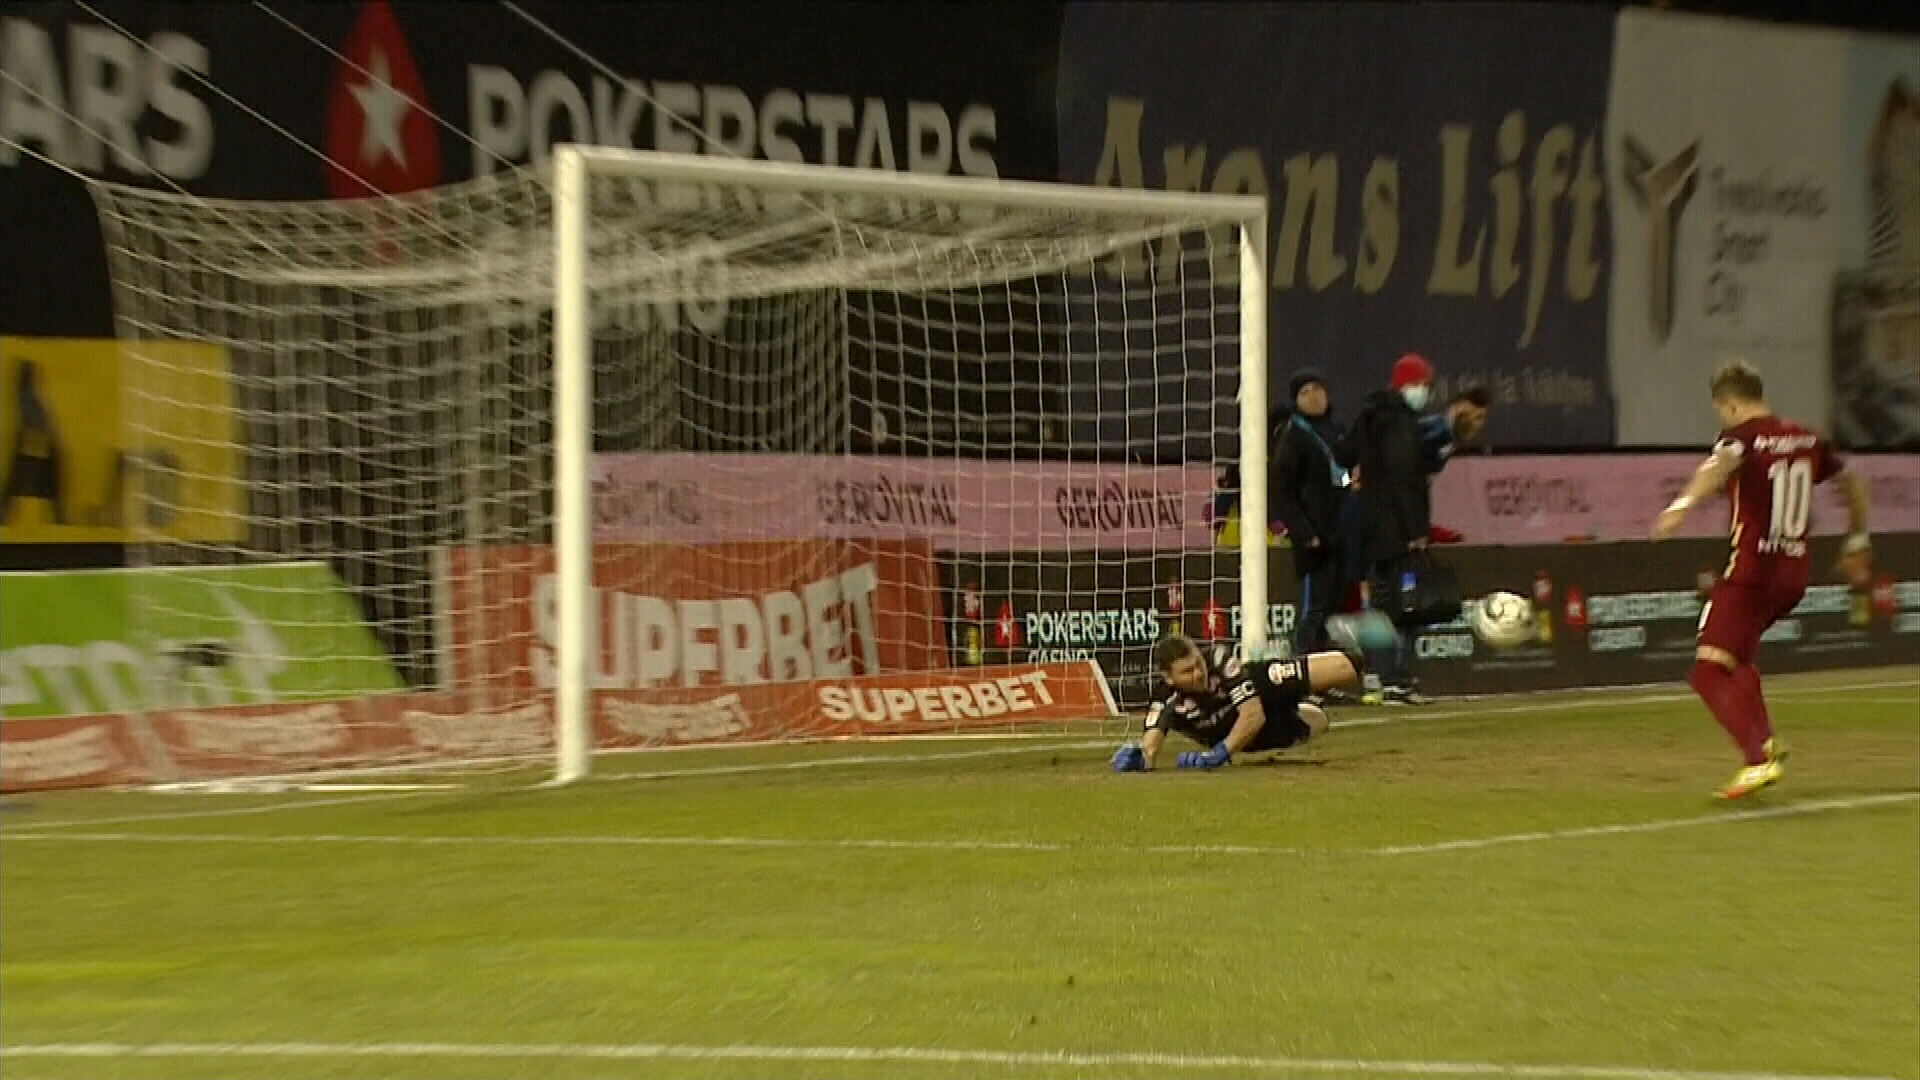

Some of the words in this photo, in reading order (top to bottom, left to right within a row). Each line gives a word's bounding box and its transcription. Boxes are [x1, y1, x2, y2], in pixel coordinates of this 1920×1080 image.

[467, 64, 999, 212] POKERSTARS
[1427, 109, 1603, 348] Lift
[1056, 481, 1183, 532] GEROVITAL
[1768, 457, 1812, 548] 10
[1026, 609, 1159, 645] POKERSTARS
[818, 670, 1054, 722] SUPERBET
